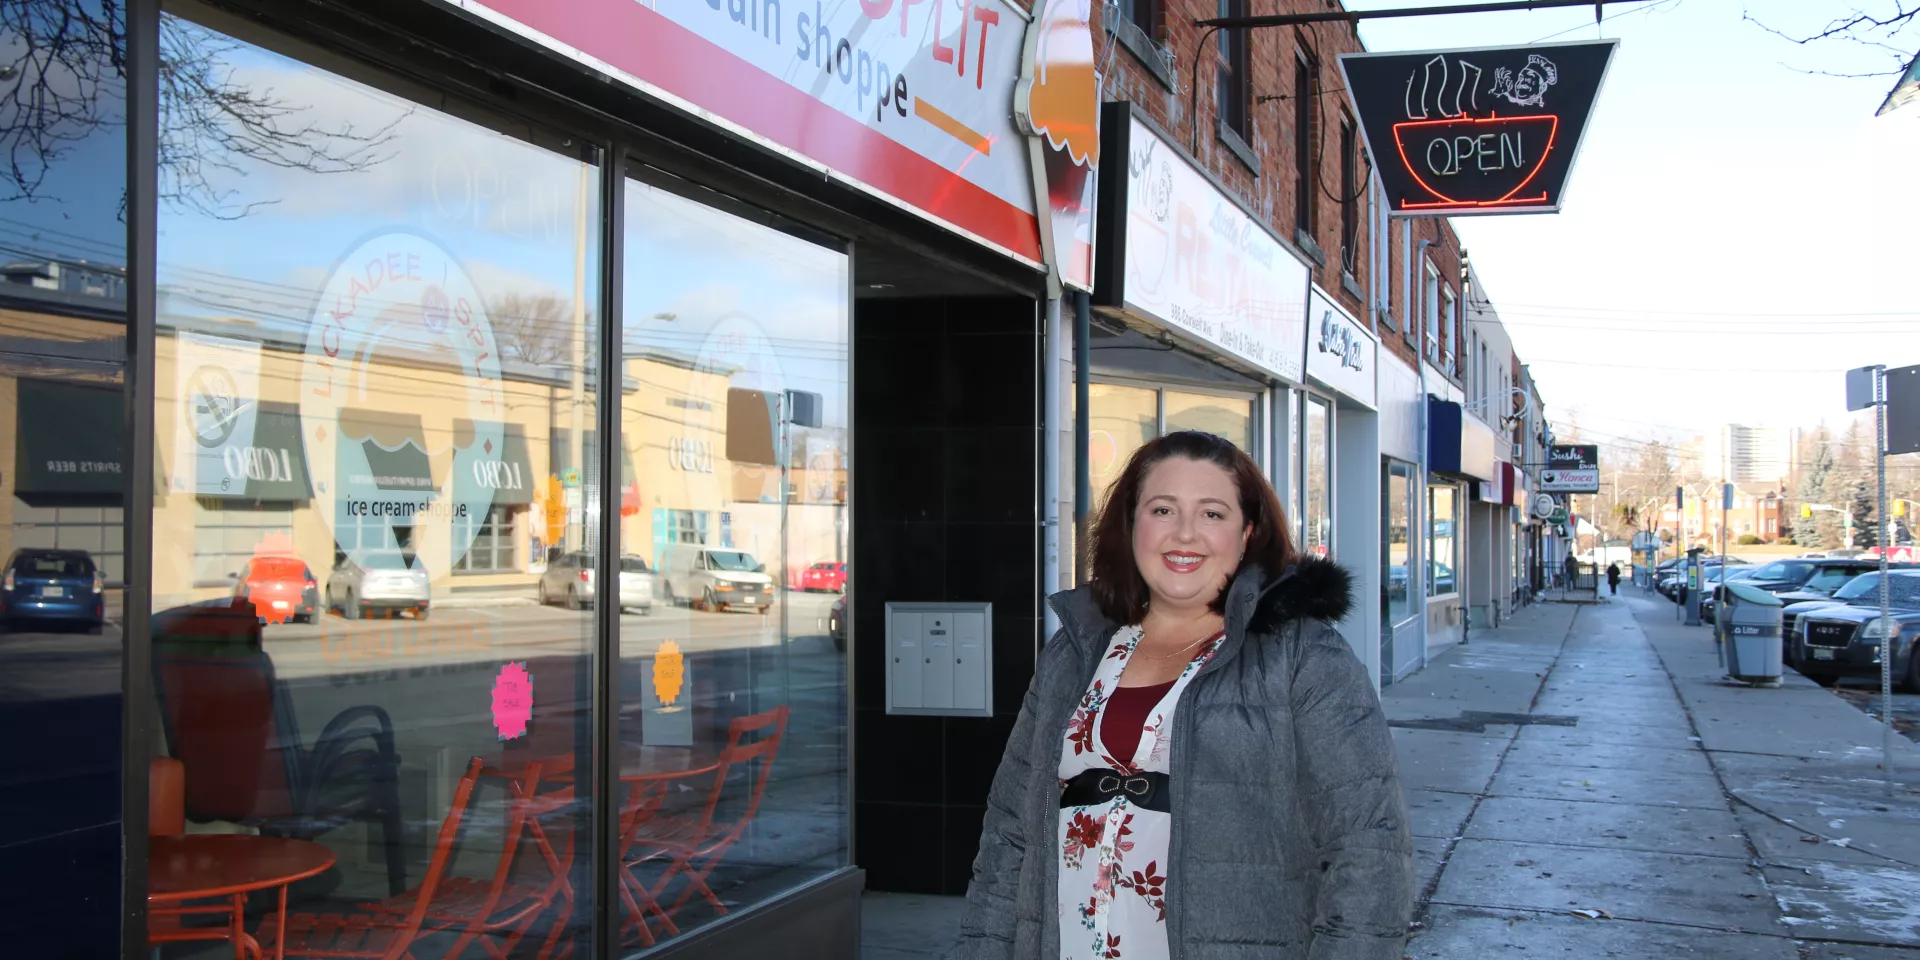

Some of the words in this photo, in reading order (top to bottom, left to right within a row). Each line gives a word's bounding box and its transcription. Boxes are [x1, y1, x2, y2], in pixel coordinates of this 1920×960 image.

[797, 1, 908, 122] shoppe
[1426, 131, 1522, 176] OPEN
[313, 252, 422, 398] LICKADEE
[454, 297, 496, 415] SPLIT
[1551, 447, 1584, 460] Sushi
[347, 494, 368, 516] ice
[371, 500, 415, 517] cream
[419, 497, 467, 523] shoppe
[1742, 626, 1759, 634] Litter
